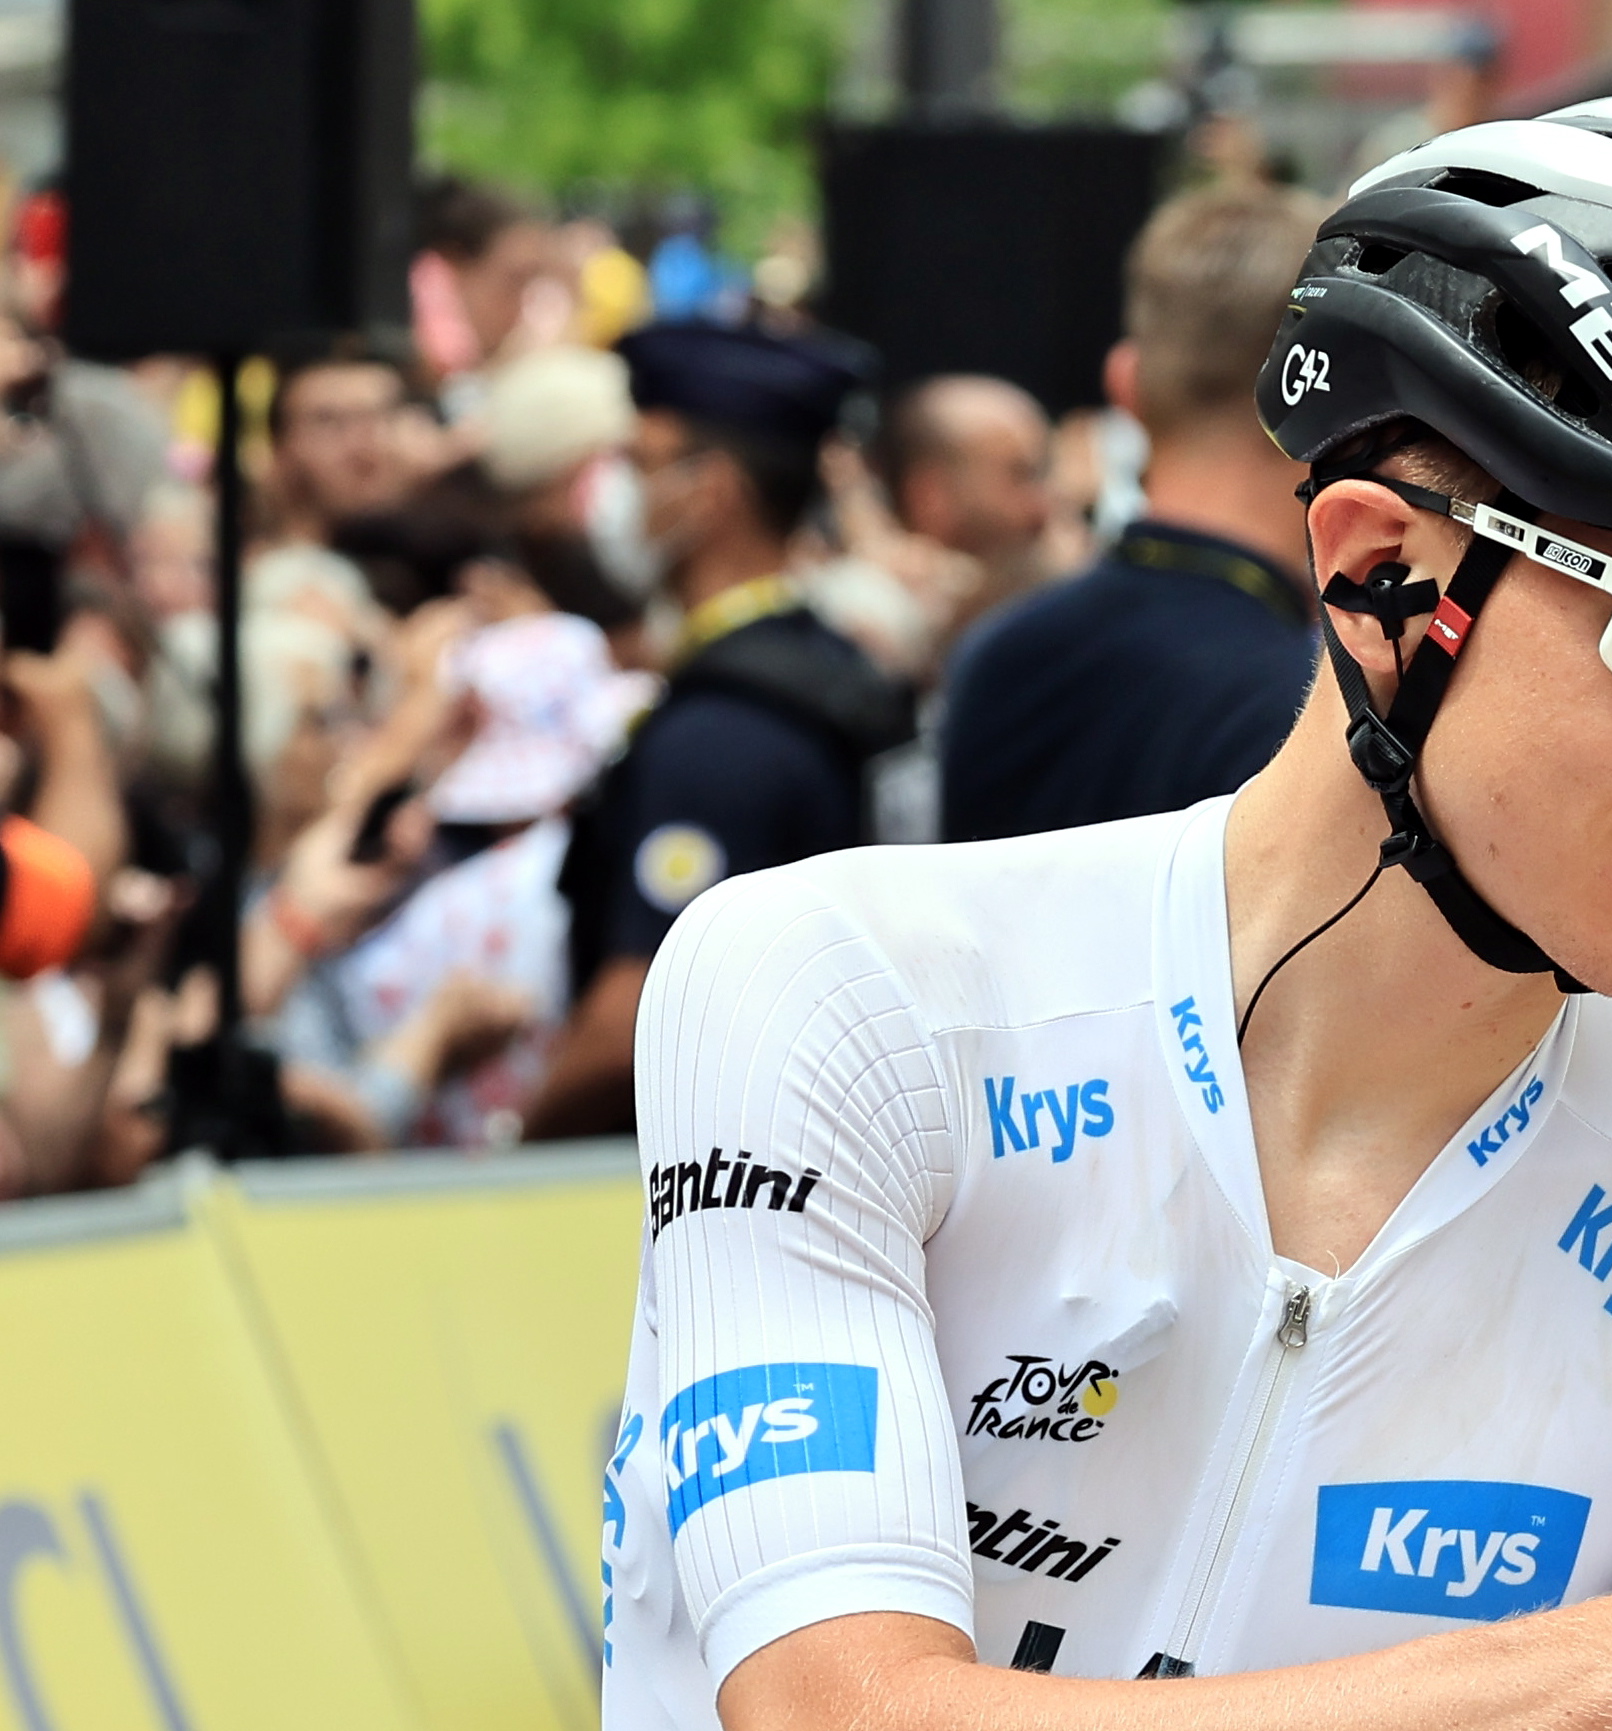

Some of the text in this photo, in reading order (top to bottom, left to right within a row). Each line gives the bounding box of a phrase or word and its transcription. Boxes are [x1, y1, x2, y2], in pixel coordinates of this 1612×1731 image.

[1281, 343, 1332, 406] G42
[1168, 995, 1225, 1117] Krys
[983, 1076, 1115, 1164] Krys
[1467, 1074, 1544, 1167] Krys
[1005, 1355, 1119, 1405] TOUR
[1057, 1395, 1079, 1414] de
[1360, 1506, 1540, 1598] Krys
